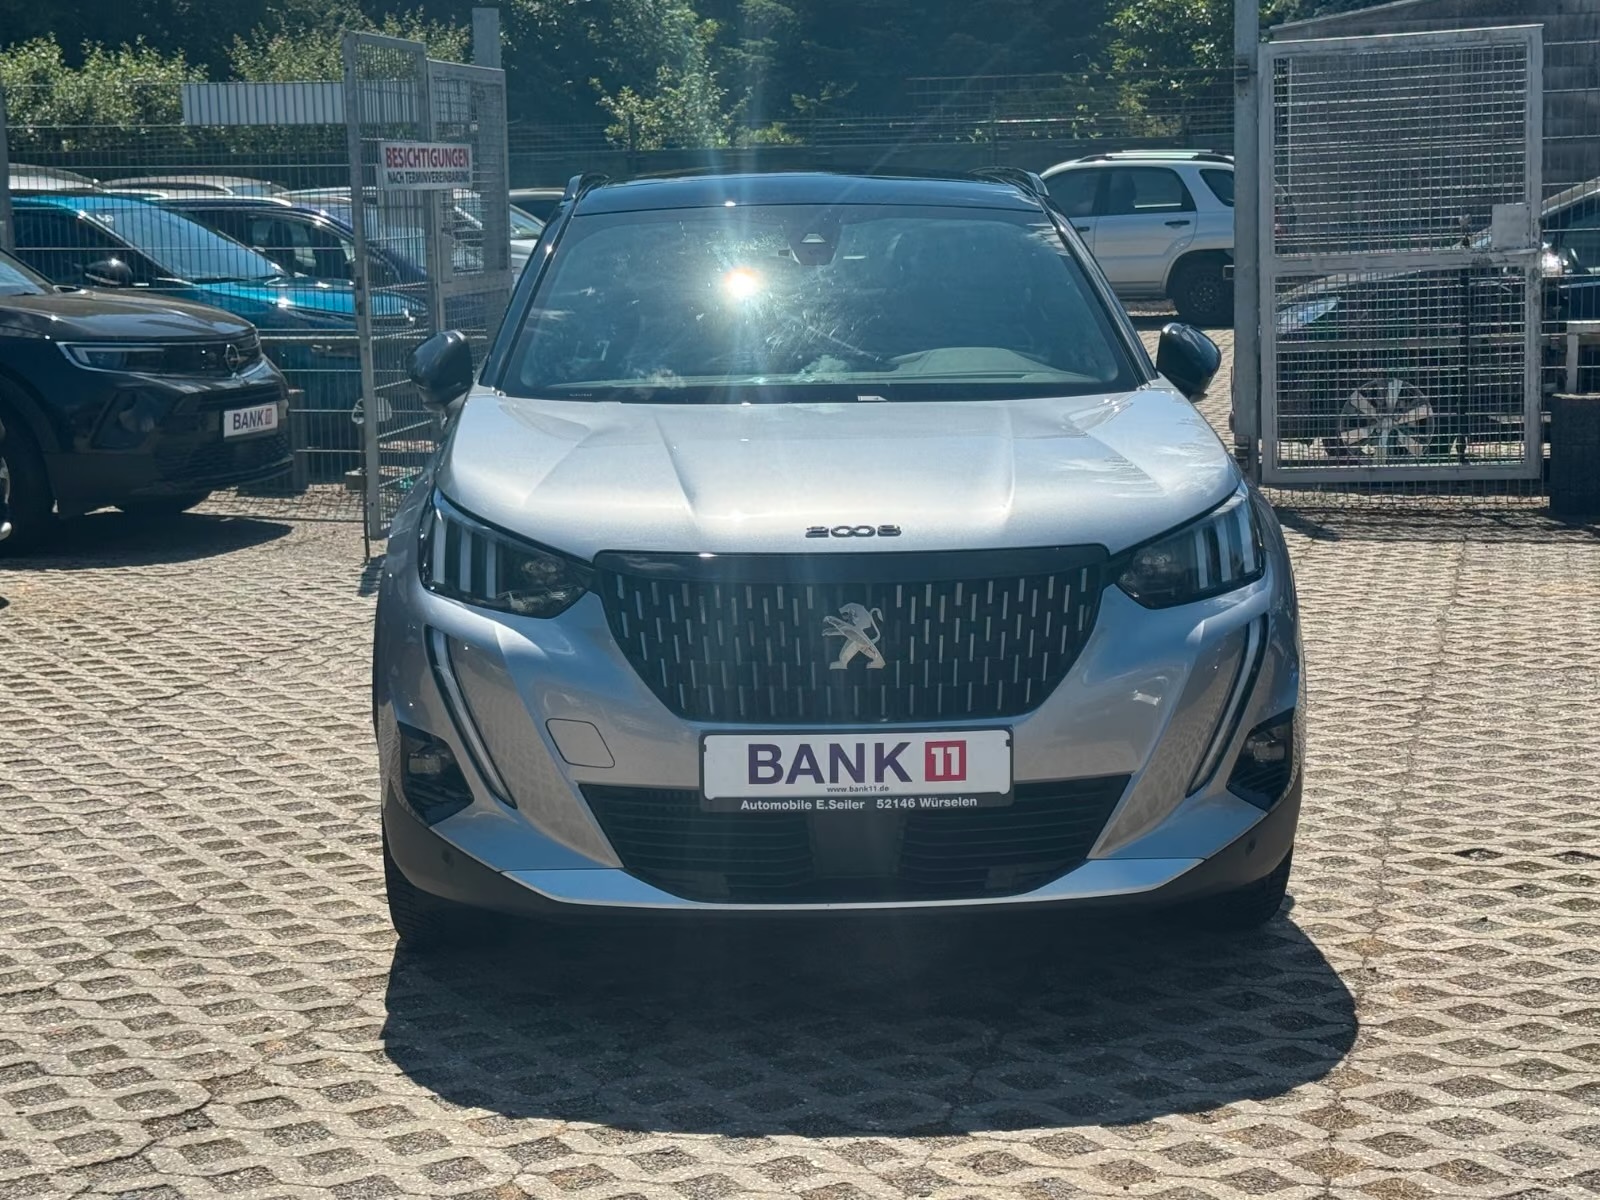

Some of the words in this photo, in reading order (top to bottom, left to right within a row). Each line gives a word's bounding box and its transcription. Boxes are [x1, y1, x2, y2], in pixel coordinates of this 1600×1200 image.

[385, 147, 469, 168] BESICHTIGUNGEN
[387, 171, 404, 184] NACH
[233, 409, 264, 430] BANK
[805, 525, 902, 538] 2008
[748, 742, 912, 785] BANK
[930, 745, 961, 777] 11
[826, 785, 889, 793] www.bank11.de
[741, 800, 812, 810] Automobile
[816, 800, 865, 810] E.Seiler
[876, 799, 916, 809] 52146
[919, 797, 978, 808] Würselen
